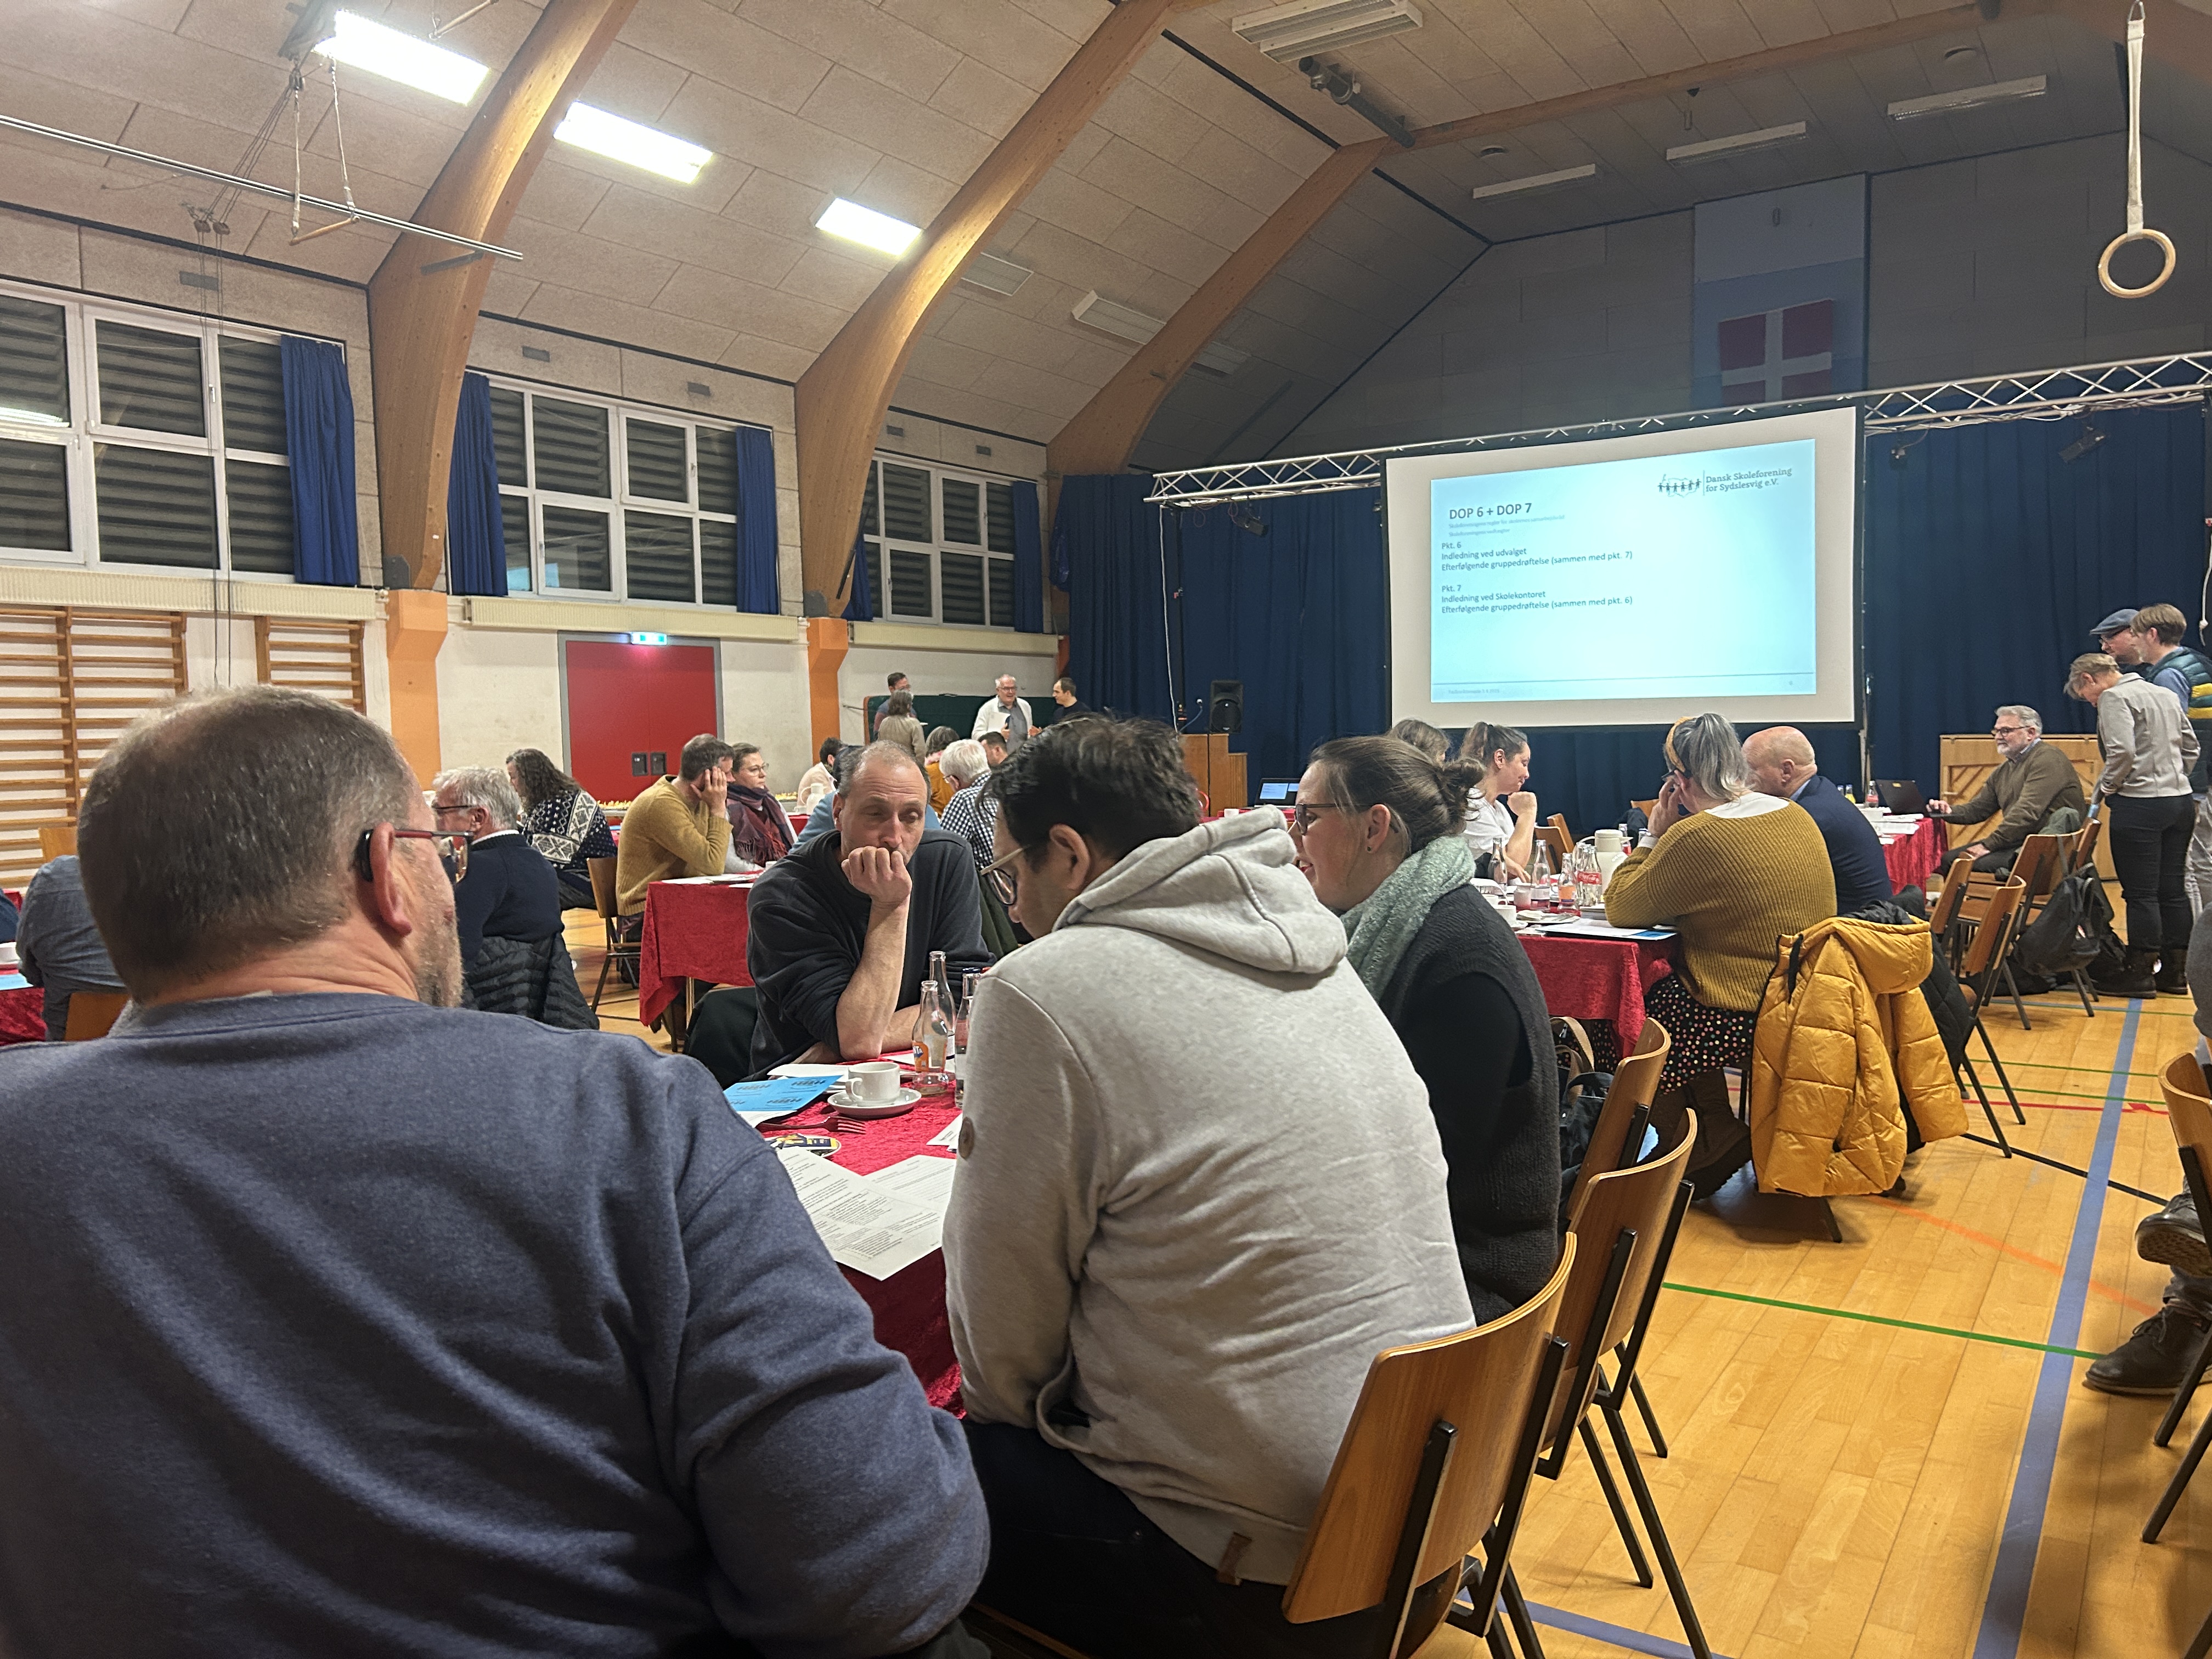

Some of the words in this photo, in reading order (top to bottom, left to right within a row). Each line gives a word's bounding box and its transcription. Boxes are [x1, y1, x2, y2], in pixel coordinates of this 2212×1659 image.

[1706, 473, 1732, 483] Dansk
[1733, 468, 1792, 480] Skoleforening
[1719, 479, 1763, 492] Sydslesvig
[1764, 478, 1779, 487] e.V.
[1449, 508, 1474, 519] DOP
[1476, 506, 1484, 517] 6
[1486, 507, 1494, 516] +
[1497, 503, 1522, 516] DOP
[1524, 503, 1532, 514] 7
[1441, 551, 1479, 560] Indledning
[1496, 548, 1527, 557] udvalget
[1441, 561, 1489, 571] Efterfølgende
[1491, 557, 1549, 569] gruppedrøftelse
[1551, 556, 1586, 565] (sammen
[1588, 553, 1606, 561] med
[1607, 552, 1623, 561] pkt.
[1625, 550, 1633, 560] 7)
[1441, 595, 1479, 603] Indledning
[1495, 591, 1546, 601] Skolekontoret
[1441, 605, 1489, 614] Efterfølgende
[1491, 601, 1550, 613] gruppedrøftelse
[1551, 600, 1587, 610] (sammen
[1588, 597, 1606, 606] med
[1607, 597, 1623, 606] pkt.
[1624, 596, 1633, 605] 6)
